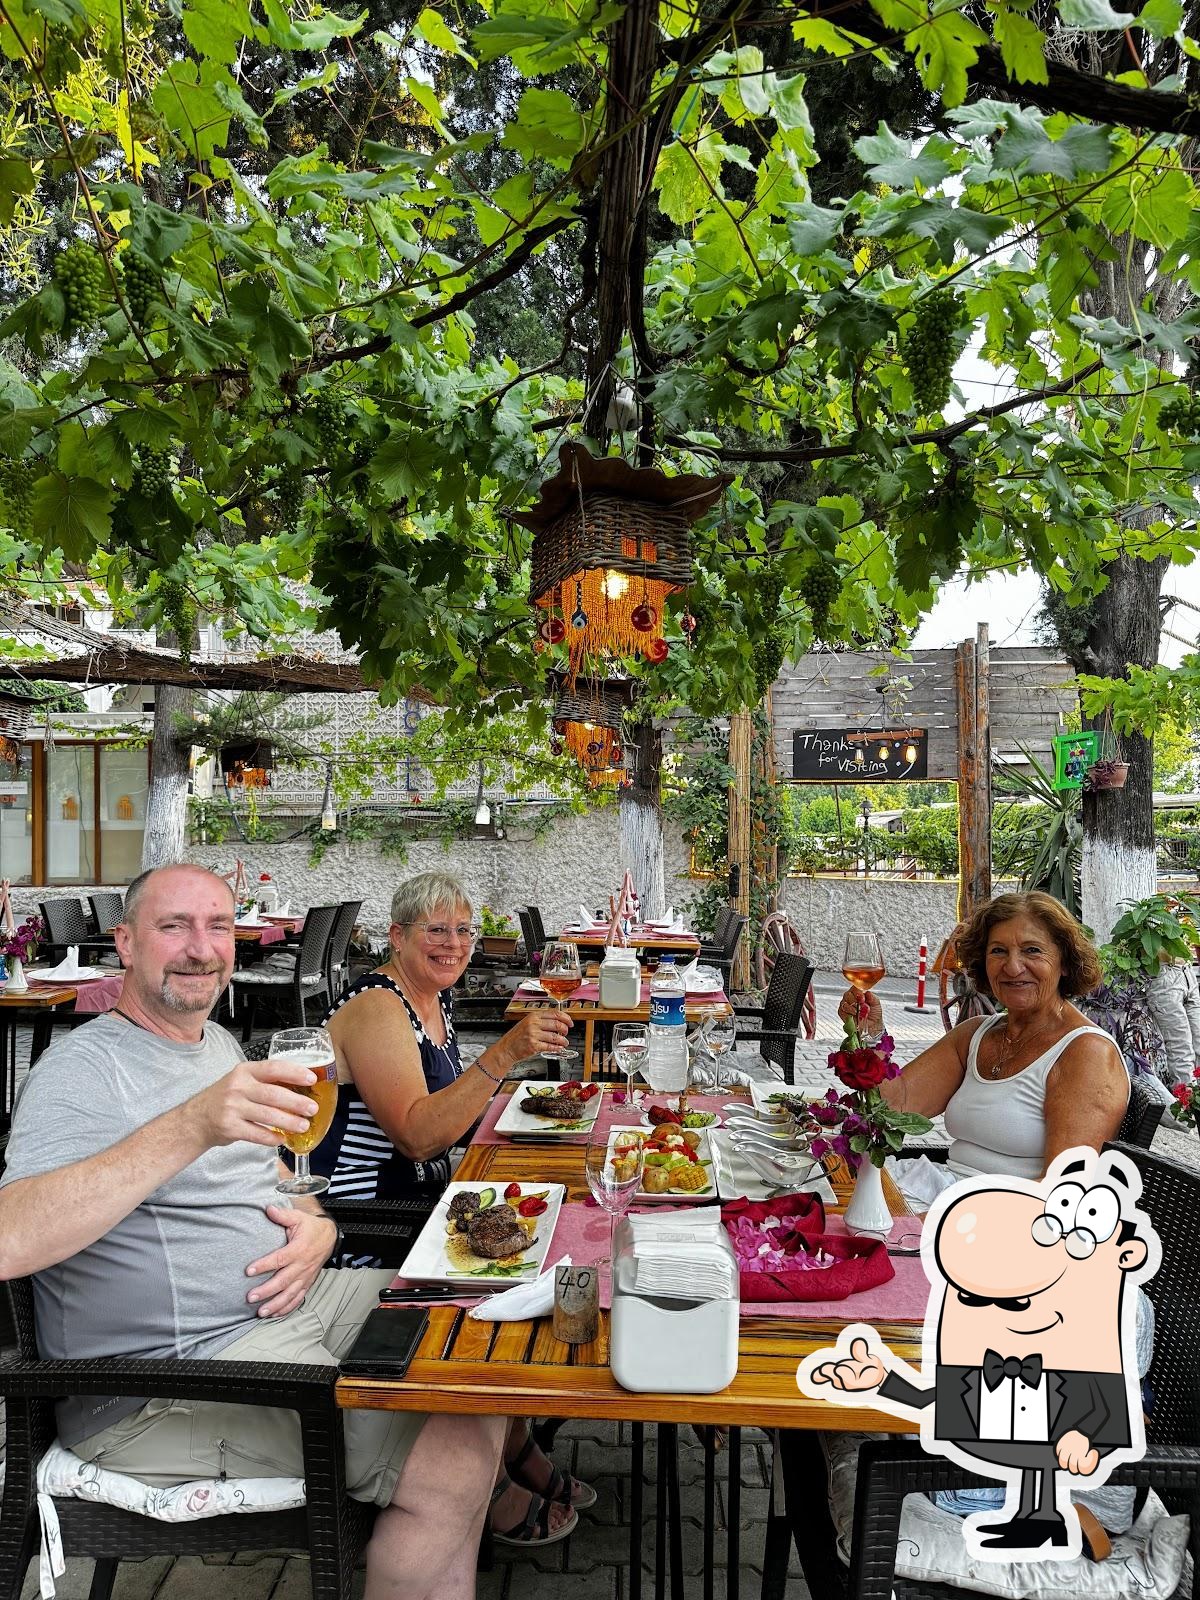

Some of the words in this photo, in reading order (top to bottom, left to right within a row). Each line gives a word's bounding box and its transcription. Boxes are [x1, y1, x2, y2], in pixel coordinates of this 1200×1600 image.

[799, 733, 855, 753] Thanks
[818, 752, 838, 767] for
[558, 1267, 591, 1299] 40
[92, 1396, 120, 1415] DRI-FIT
